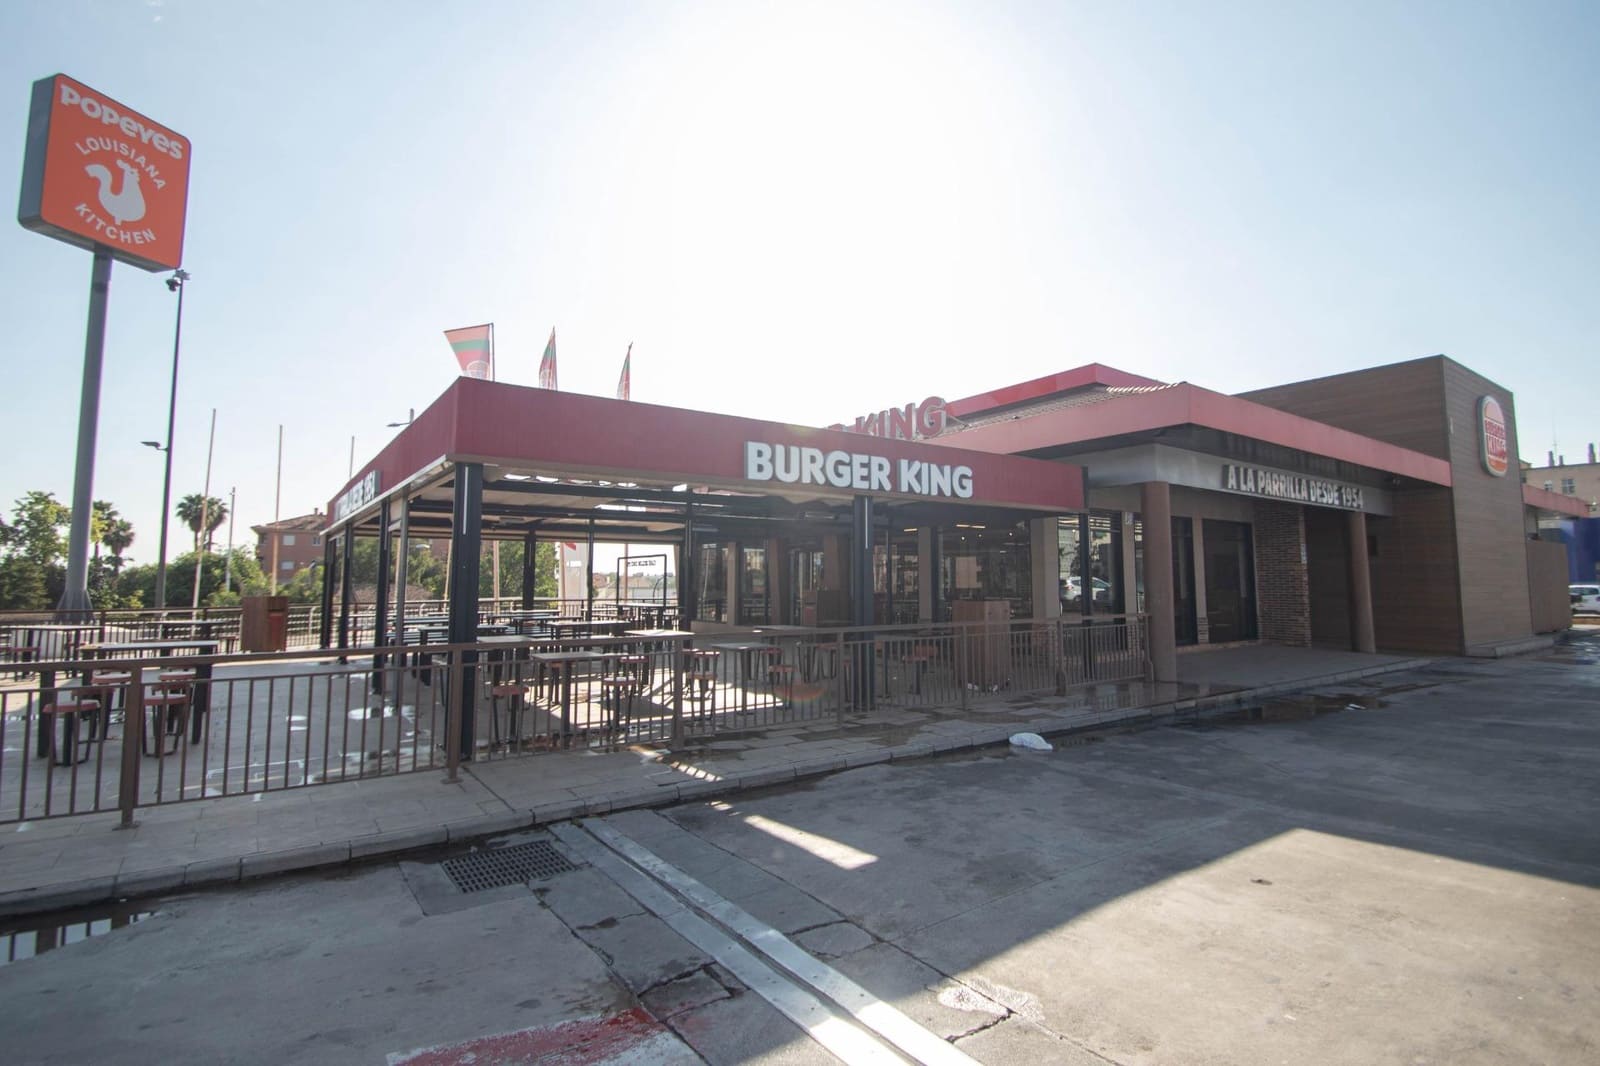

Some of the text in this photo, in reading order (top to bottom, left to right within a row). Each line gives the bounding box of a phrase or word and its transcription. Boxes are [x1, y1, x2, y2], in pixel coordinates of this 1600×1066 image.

[75, 137, 166, 190] LOUISIANA
[75, 203, 156, 244] KITCHEN
[856, 396, 946, 440] KING
[745, 441, 973, 498] BURGER KING
[1228, 465, 1364, 509] A LA PARRILLA DESDE 1954
